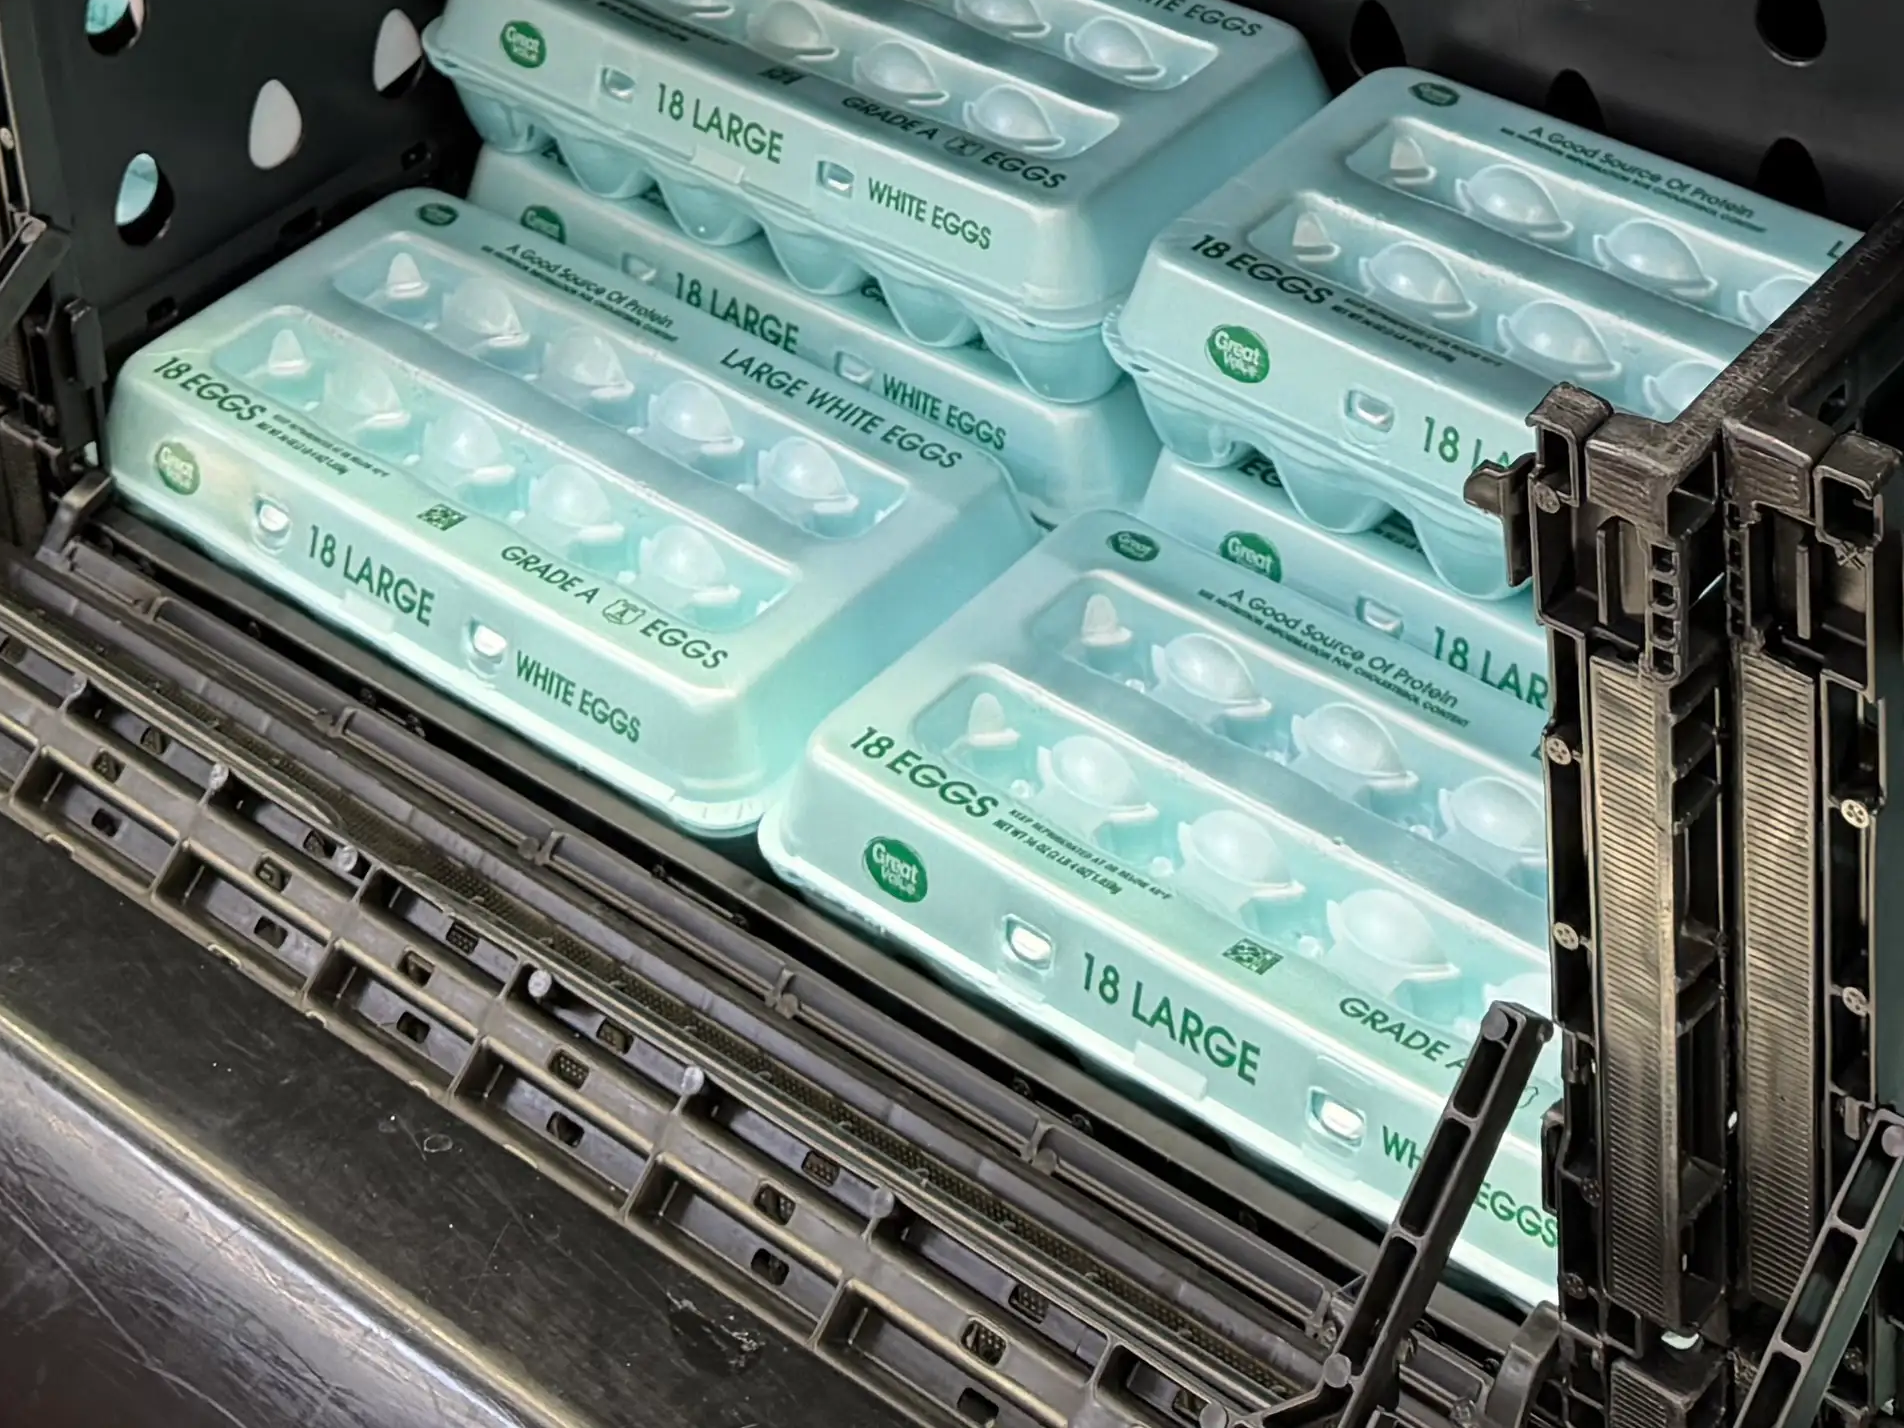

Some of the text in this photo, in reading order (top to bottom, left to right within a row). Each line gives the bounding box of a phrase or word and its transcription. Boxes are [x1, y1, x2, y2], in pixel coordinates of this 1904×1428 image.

[655, 82, 992, 251] 18 LARGE WHITE EGGS
[1229, 589, 1459, 709] A Good Source Of Protein
[850, 726, 998, 817] 18 EGGS
[872, 842, 919, 880] Great
[1083, 952, 1261, 1086] 18 LARGE
